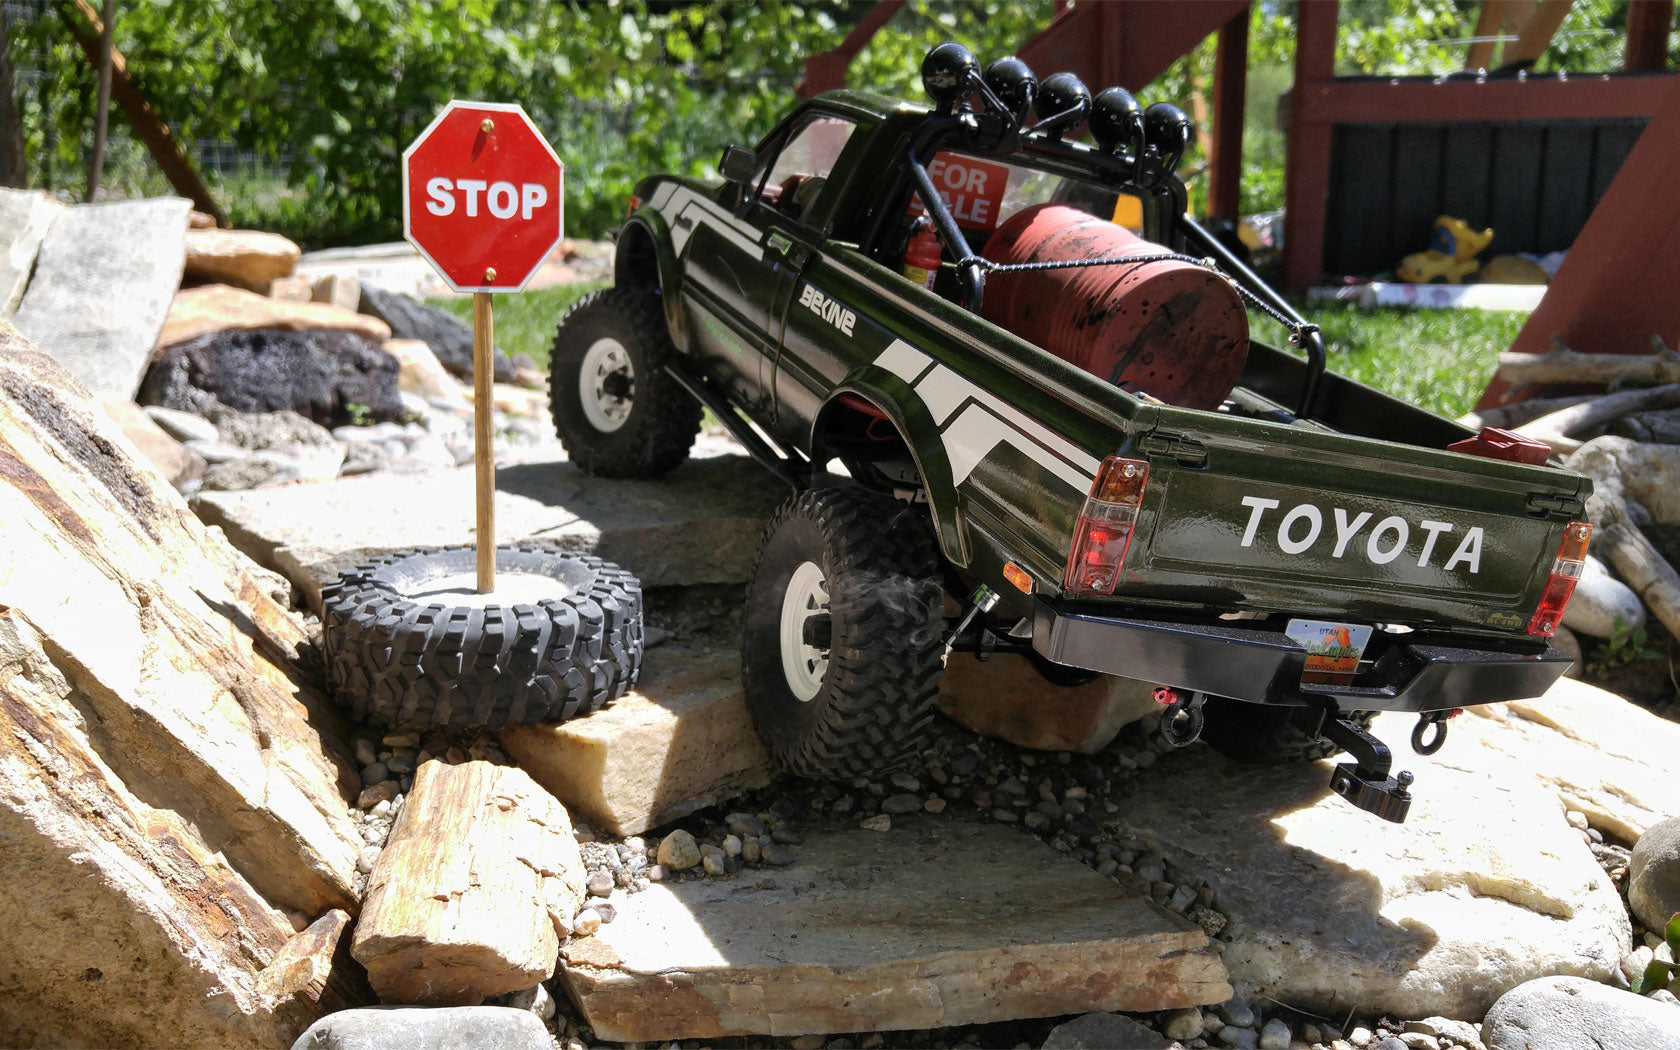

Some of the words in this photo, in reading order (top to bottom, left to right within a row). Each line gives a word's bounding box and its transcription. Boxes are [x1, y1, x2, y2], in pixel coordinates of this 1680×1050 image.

[927, 160, 988, 195] FOR
[426, 177, 548, 220] STOP
[1240, 495, 1484, 574] TOYOTA
[1319, 627, 1340, 636] UTAH
